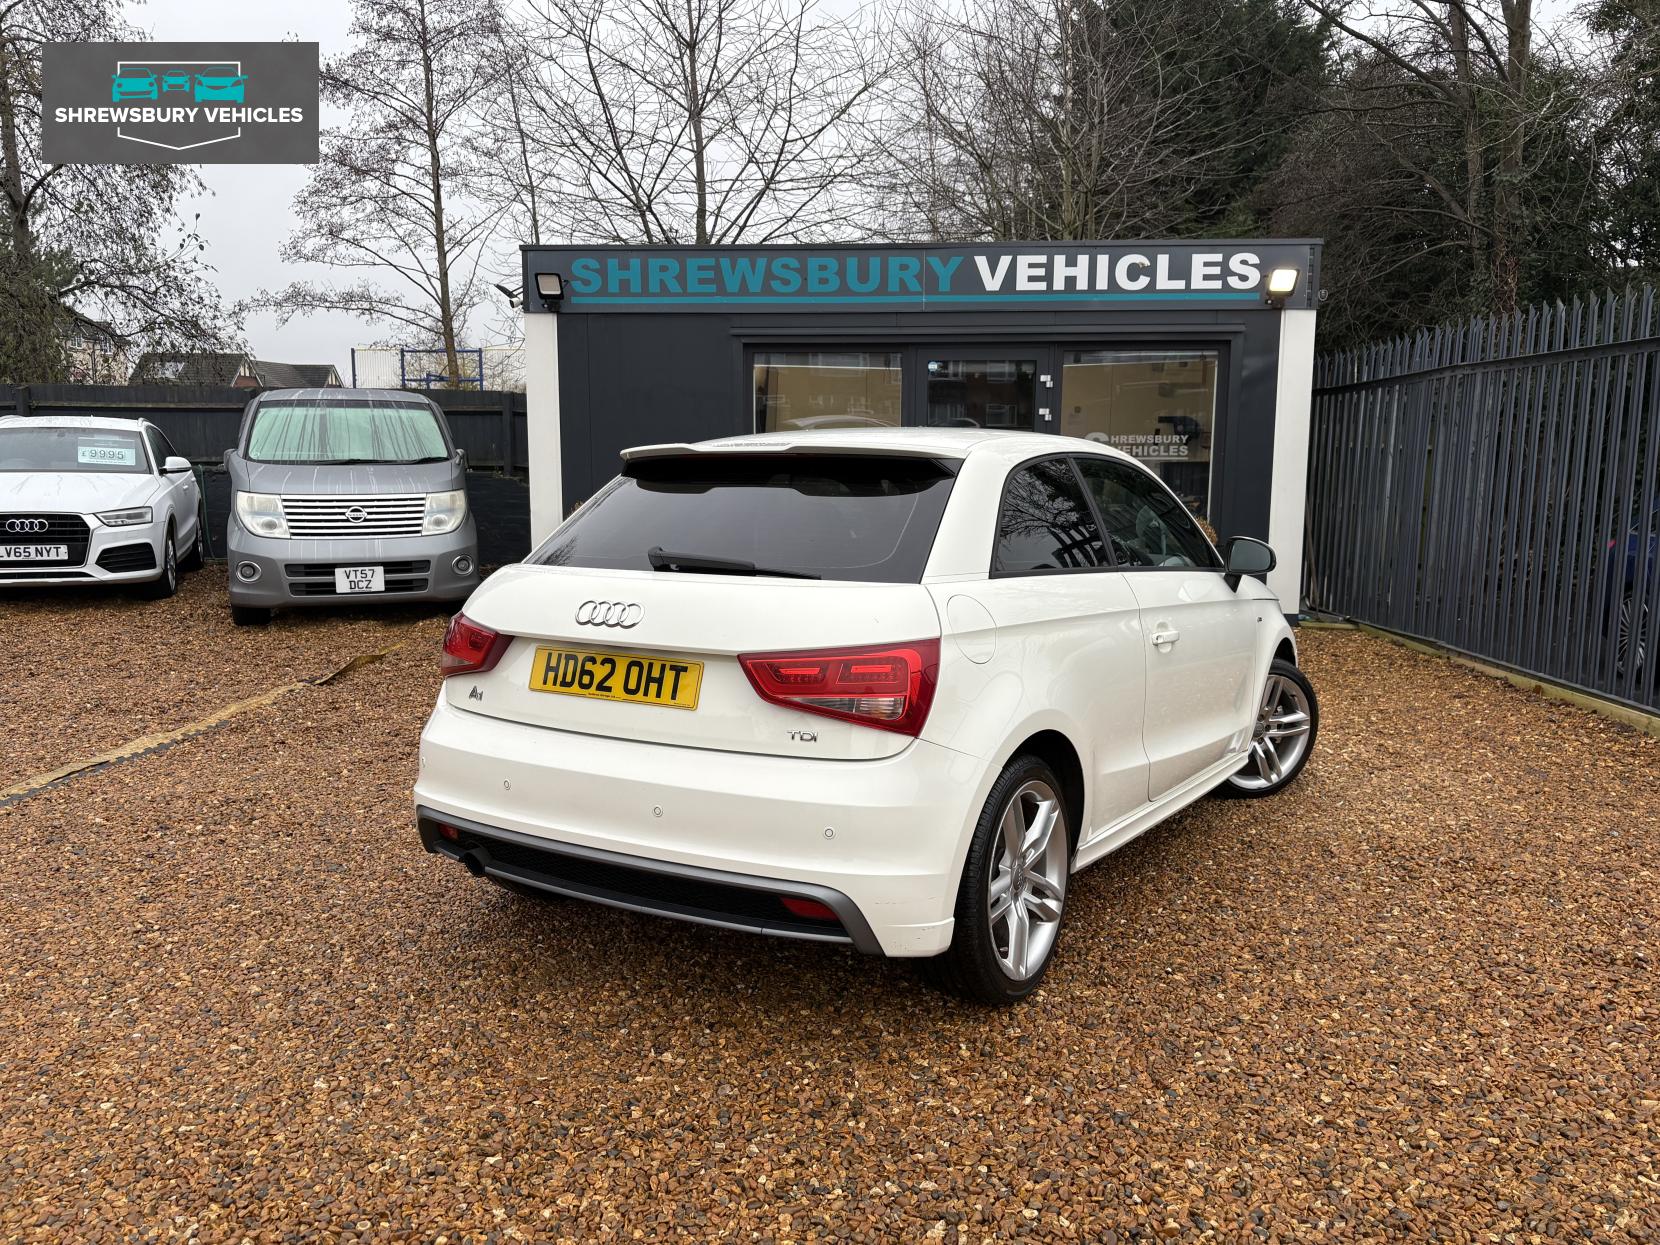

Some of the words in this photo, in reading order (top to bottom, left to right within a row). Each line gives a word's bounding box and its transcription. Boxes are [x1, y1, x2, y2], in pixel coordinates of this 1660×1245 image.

[571, 256, 964, 293] SHREWSBURY
[973, 252, 1261, 292] VEHICLES
[1114, 445, 1189, 456] EHICLES
[35, 546, 61, 558] NYT
[344, 568, 375, 580] VT57
[349, 579, 373, 590] DCZ
[542, 652, 617, 693] HD62
[622, 660, 689, 701] OHT
[786, 730, 818, 742] TDI
